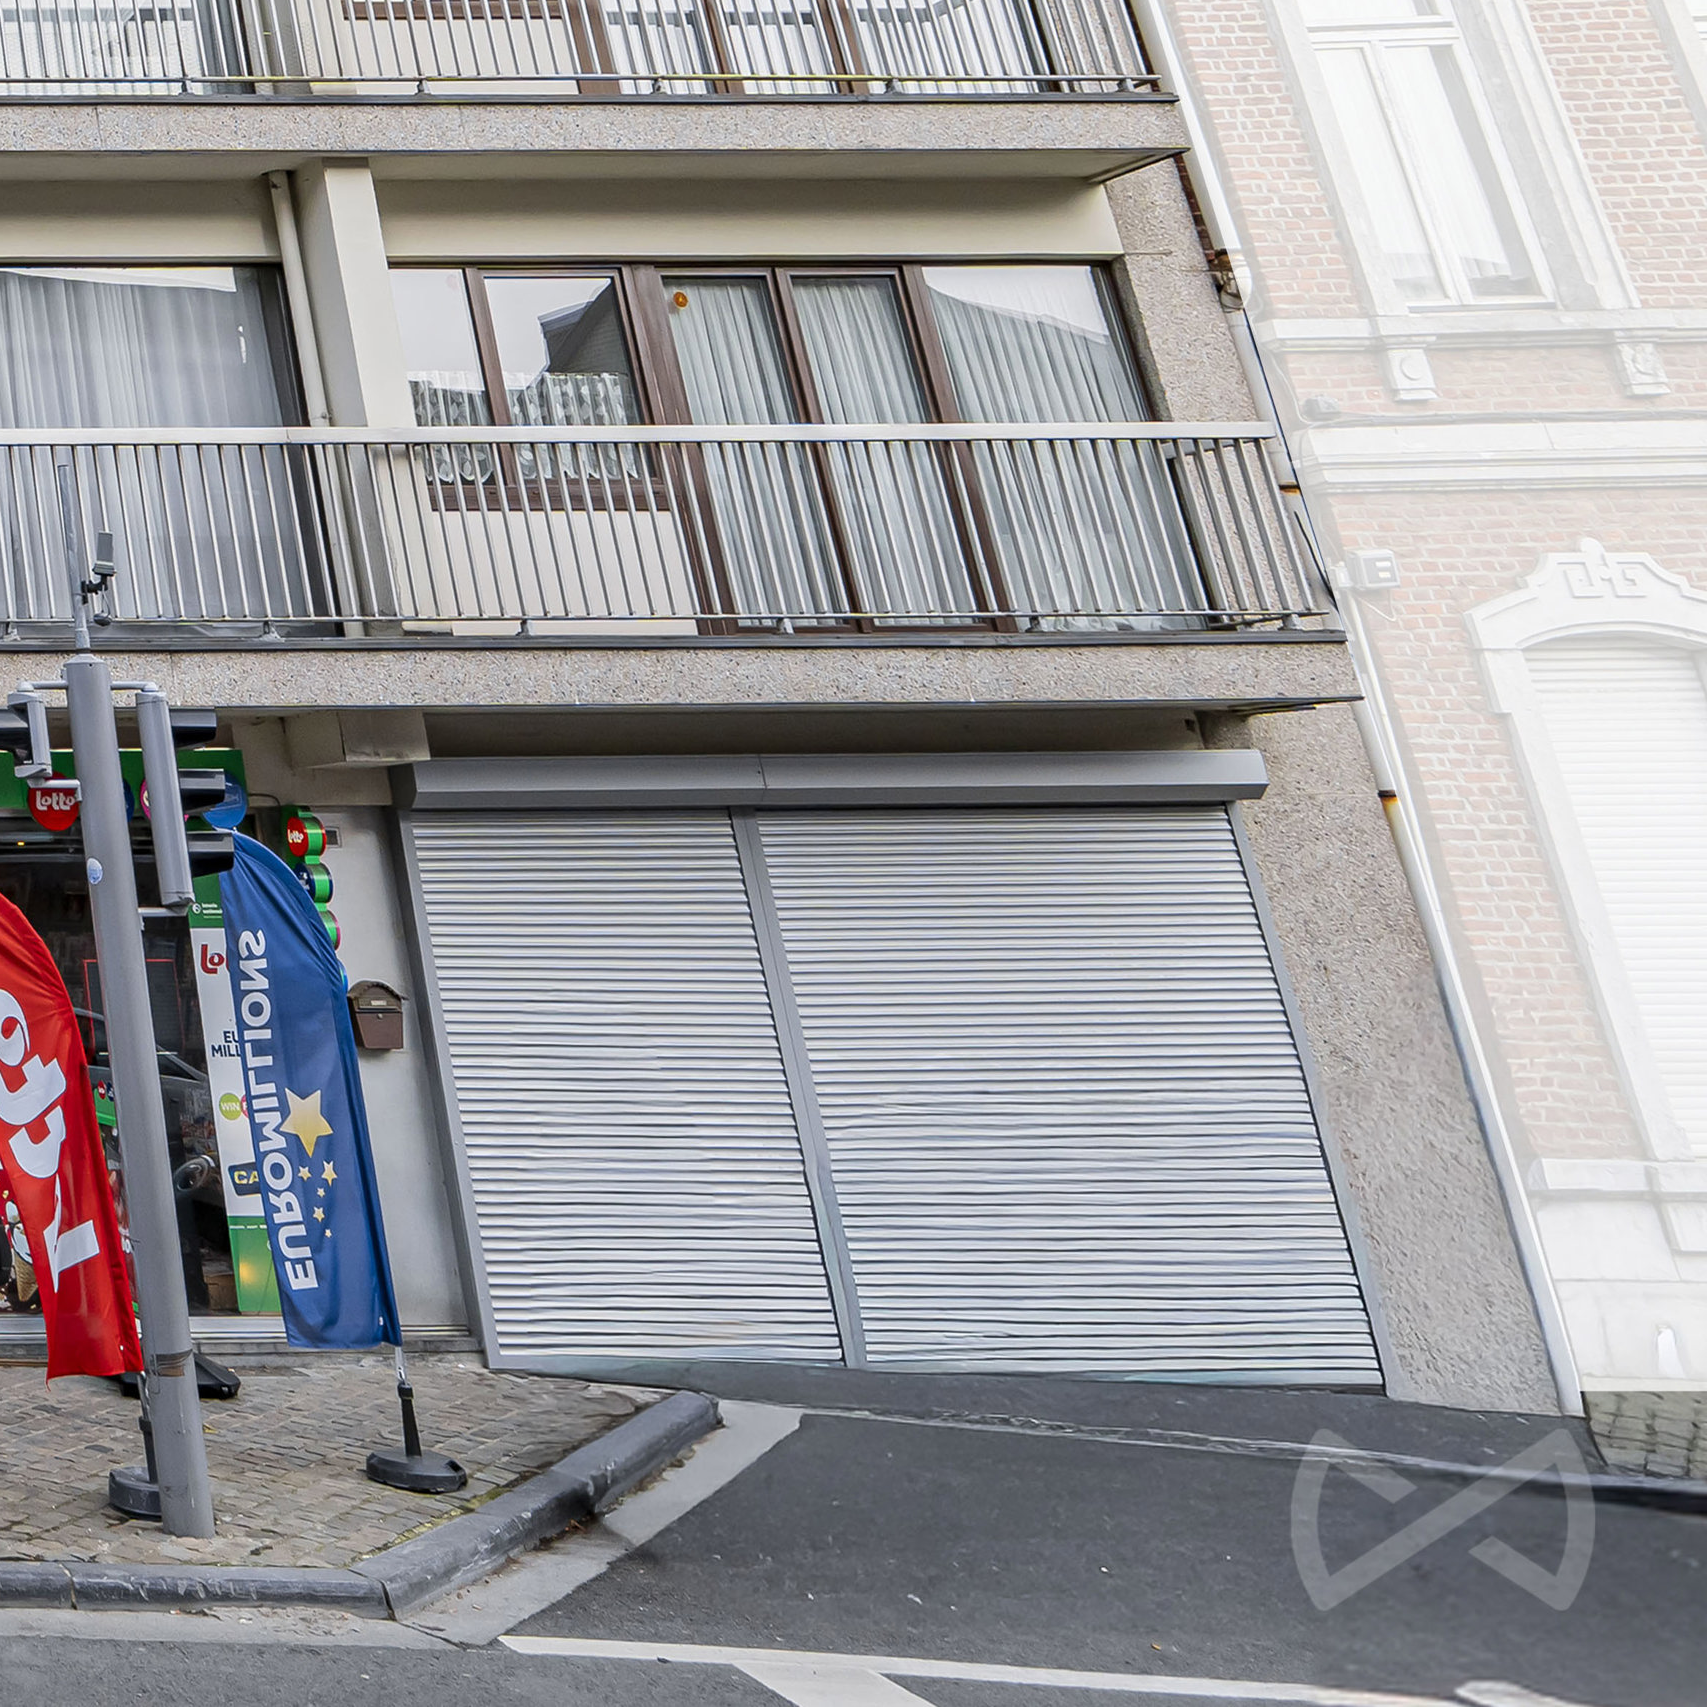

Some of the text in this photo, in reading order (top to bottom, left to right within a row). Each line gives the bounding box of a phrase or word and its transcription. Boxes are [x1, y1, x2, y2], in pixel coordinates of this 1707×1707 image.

[223, 1030, 239, 1044] EU
[211, 1045, 242, 1058] MILL
[220, 1101, 241, 1111] WIN
[234, 1170, 260, 1185] CA
